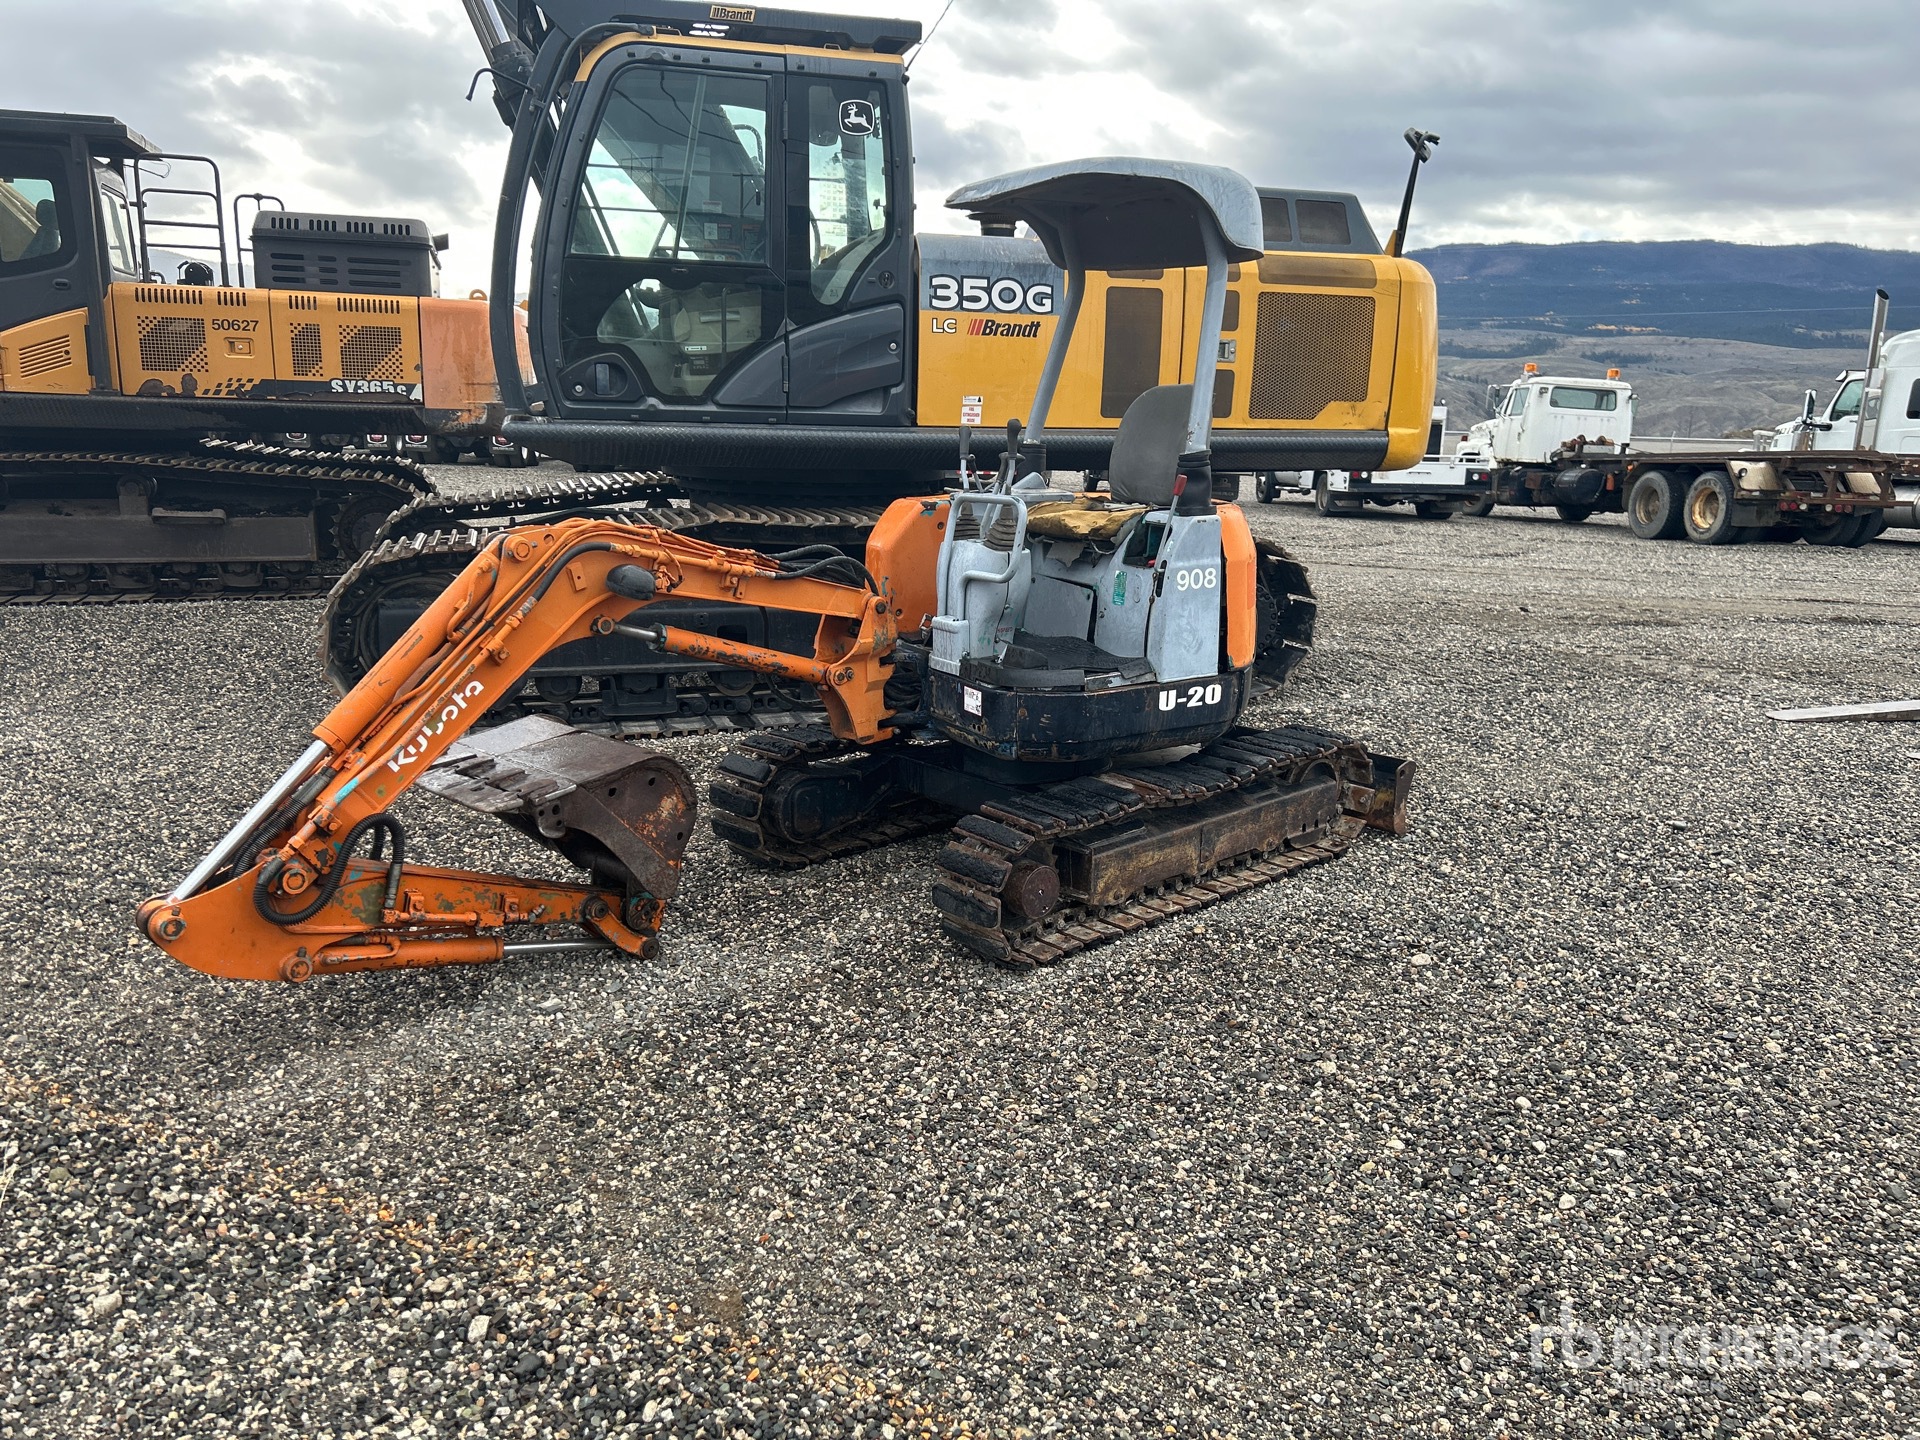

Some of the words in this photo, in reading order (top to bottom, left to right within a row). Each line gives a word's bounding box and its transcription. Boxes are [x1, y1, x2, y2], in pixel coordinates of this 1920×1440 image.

[720, 8, 753, 21] Brandt
[930, 275, 1053, 314] 350G
[211, 318, 259, 332] 50627
[932, 318, 957, 333] LC
[980, 319, 1041, 338] Brandt
[1176, 567, 1217, 592] 908
[1158, 683, 1222, 712] U-20
[387, 680, 485, 773] Kubota
